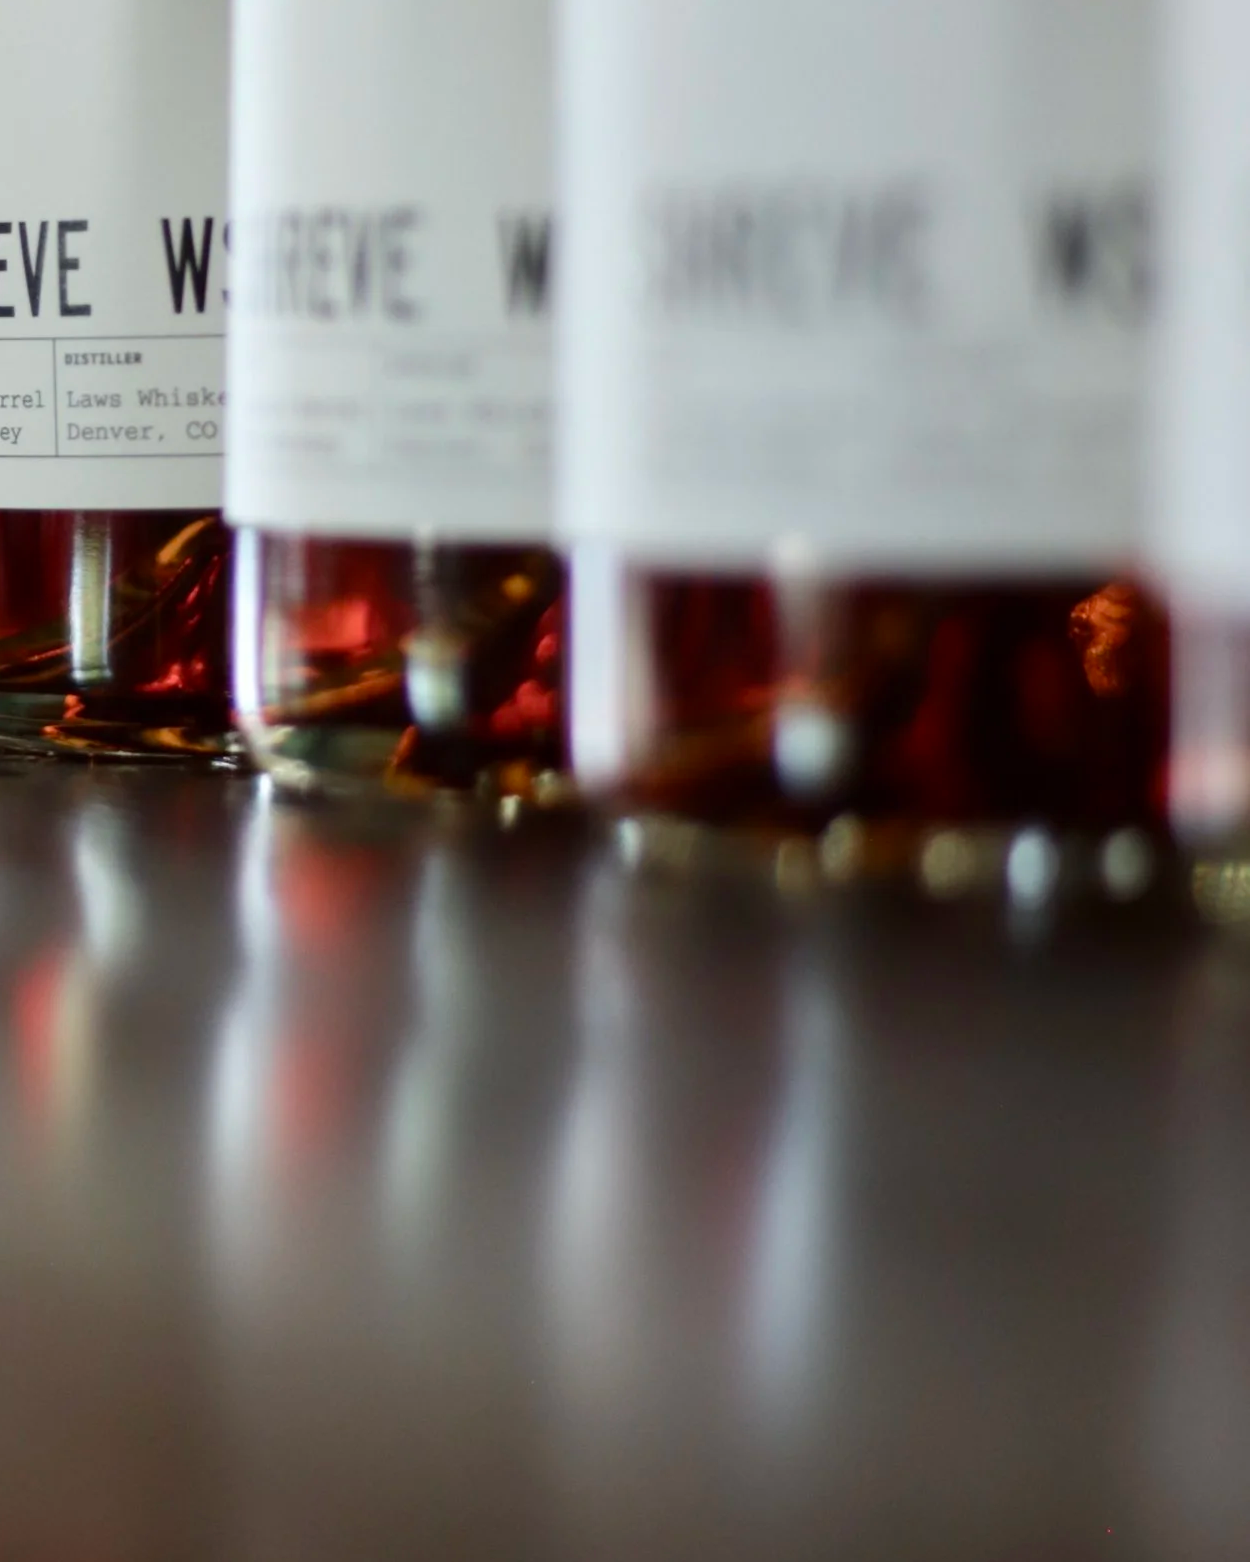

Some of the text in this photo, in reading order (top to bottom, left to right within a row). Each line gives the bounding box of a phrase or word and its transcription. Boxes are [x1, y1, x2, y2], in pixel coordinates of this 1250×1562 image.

[64, 352, 143, 366] DISTILLER
[66, 390, 123, 409] Laws
[66, 420, 219, 442] Denver, CO
